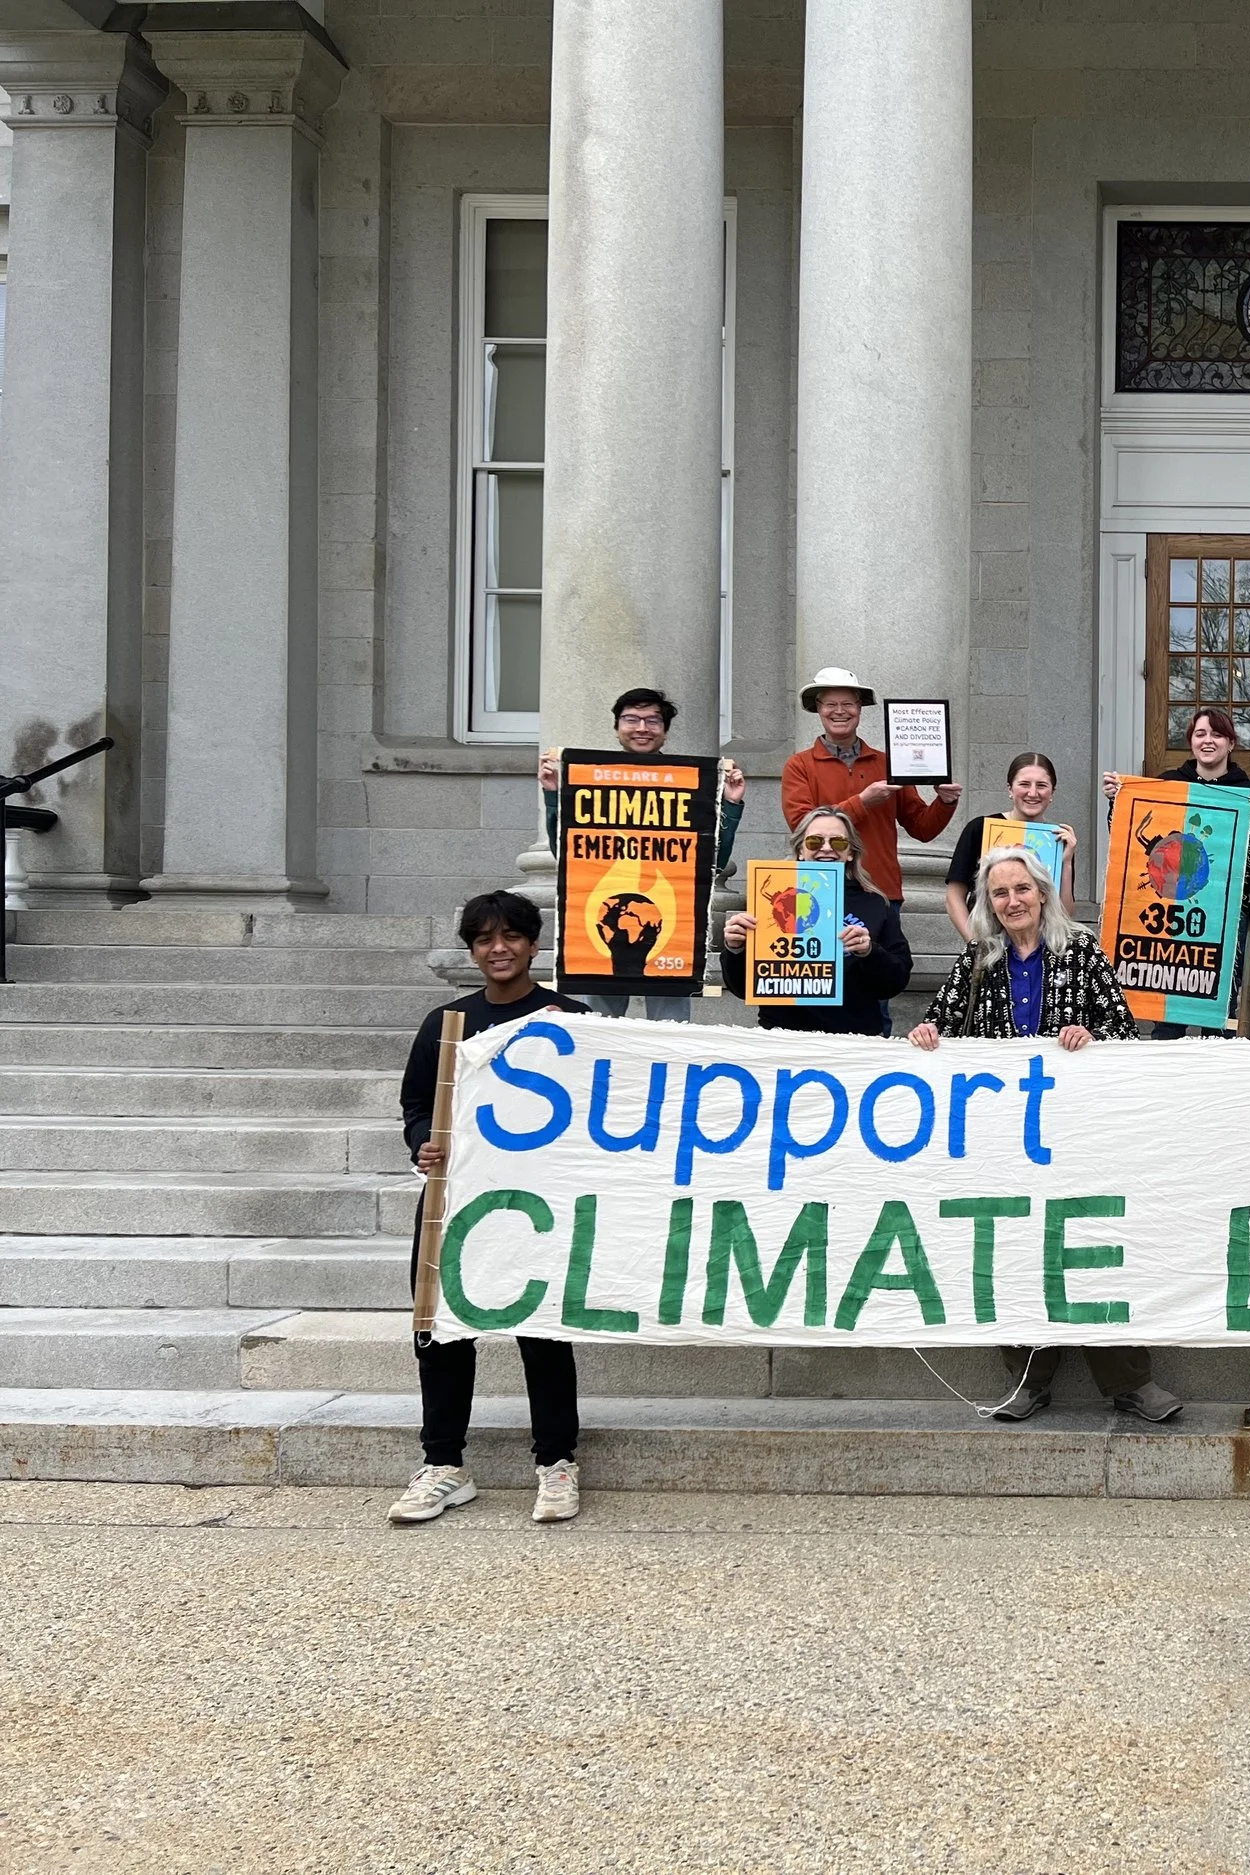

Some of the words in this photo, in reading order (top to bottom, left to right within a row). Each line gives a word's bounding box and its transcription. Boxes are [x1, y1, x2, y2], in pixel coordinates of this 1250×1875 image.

[593, 768, 658, 783] DECLARE
[664, 772, 674, 783] A
[574, 788, 691, 827] CLIMATE
[573, 834, 692, 862] EMERGENCY
[656, 956, 684, 970] 350
[1120, 938, 1217, 968] CLIMATE
[757, 963, 833, 977] CLIMATE
[1116, 960, 1176, 990] ACTION
[1176, 966, 1216, 995] NOW
[756, 978, 802, 994] ACTION
[803, 978, 833, 995] NOW
[475, 1022, 1055, 1190] Support
[439, 1189, 1130, 1332] CLIMATE
